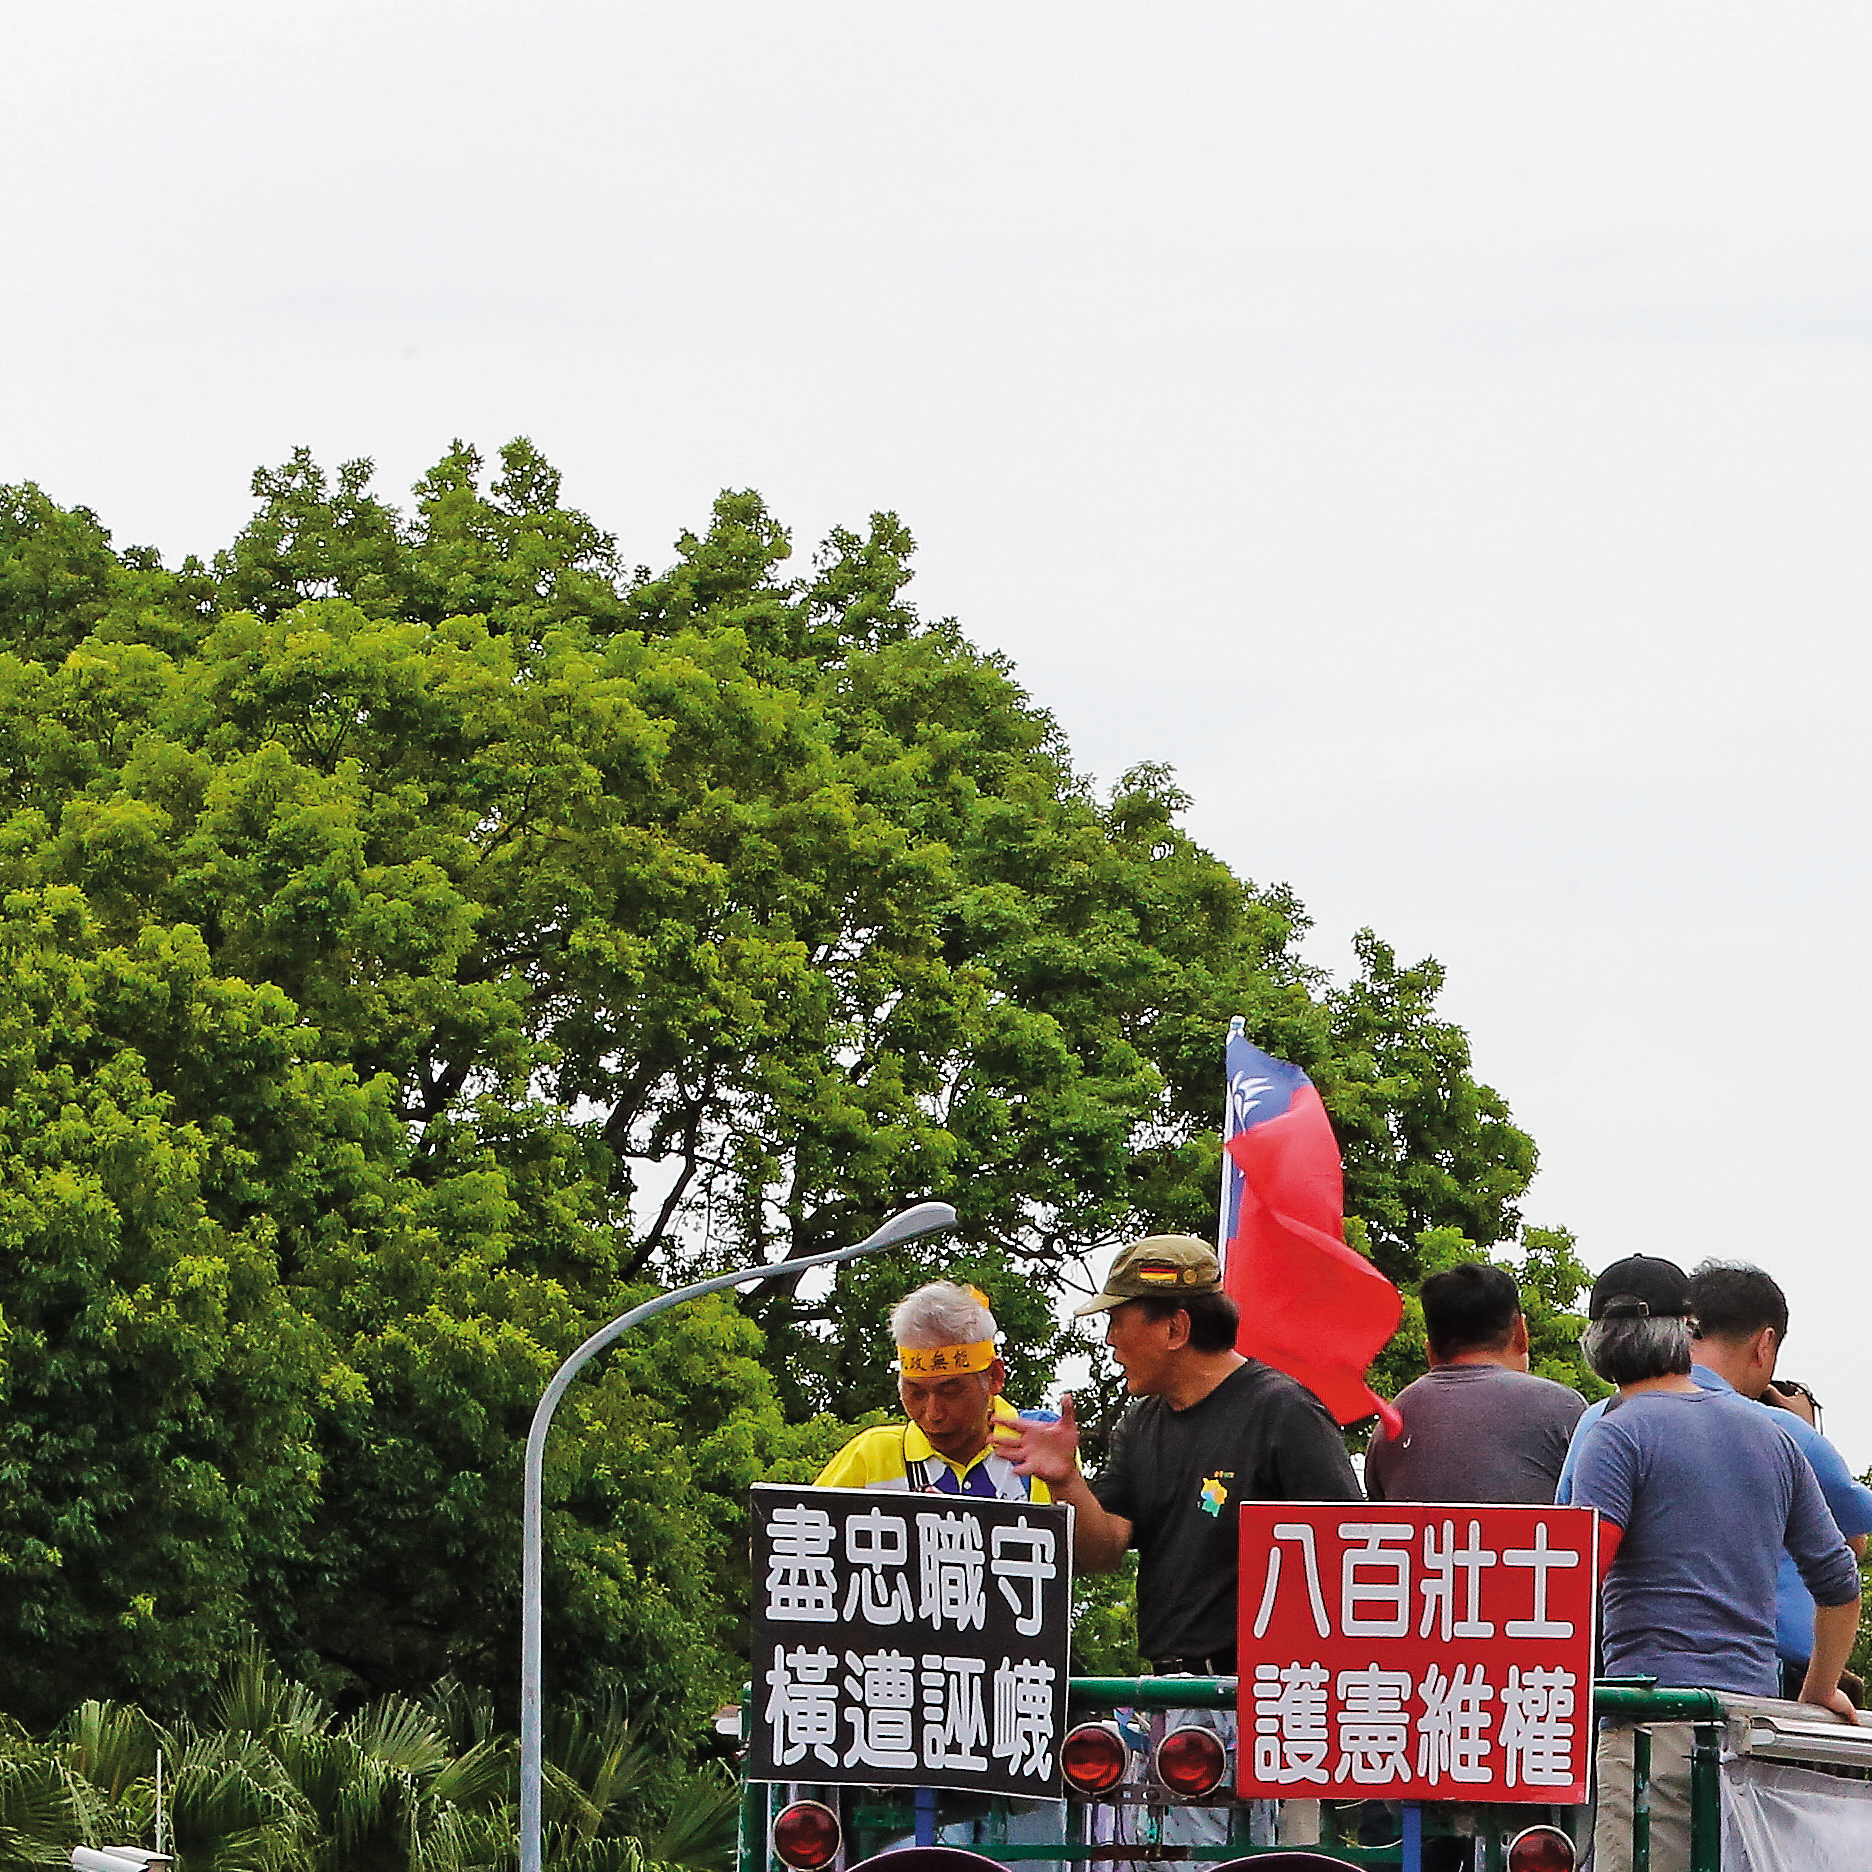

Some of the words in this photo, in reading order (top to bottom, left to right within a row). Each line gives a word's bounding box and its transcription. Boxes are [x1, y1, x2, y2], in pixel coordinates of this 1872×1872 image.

[900, 1349, 970, 1372] 政無能
[765, 1503, 1057, 1637] 盡忠職守
[1253, 1519, 1580, 1643] 八百壯士
[765, 1644, 1056, 1782] 橫遭誣衊
[1253, 1660, 1577, 1788] 護憲維權
